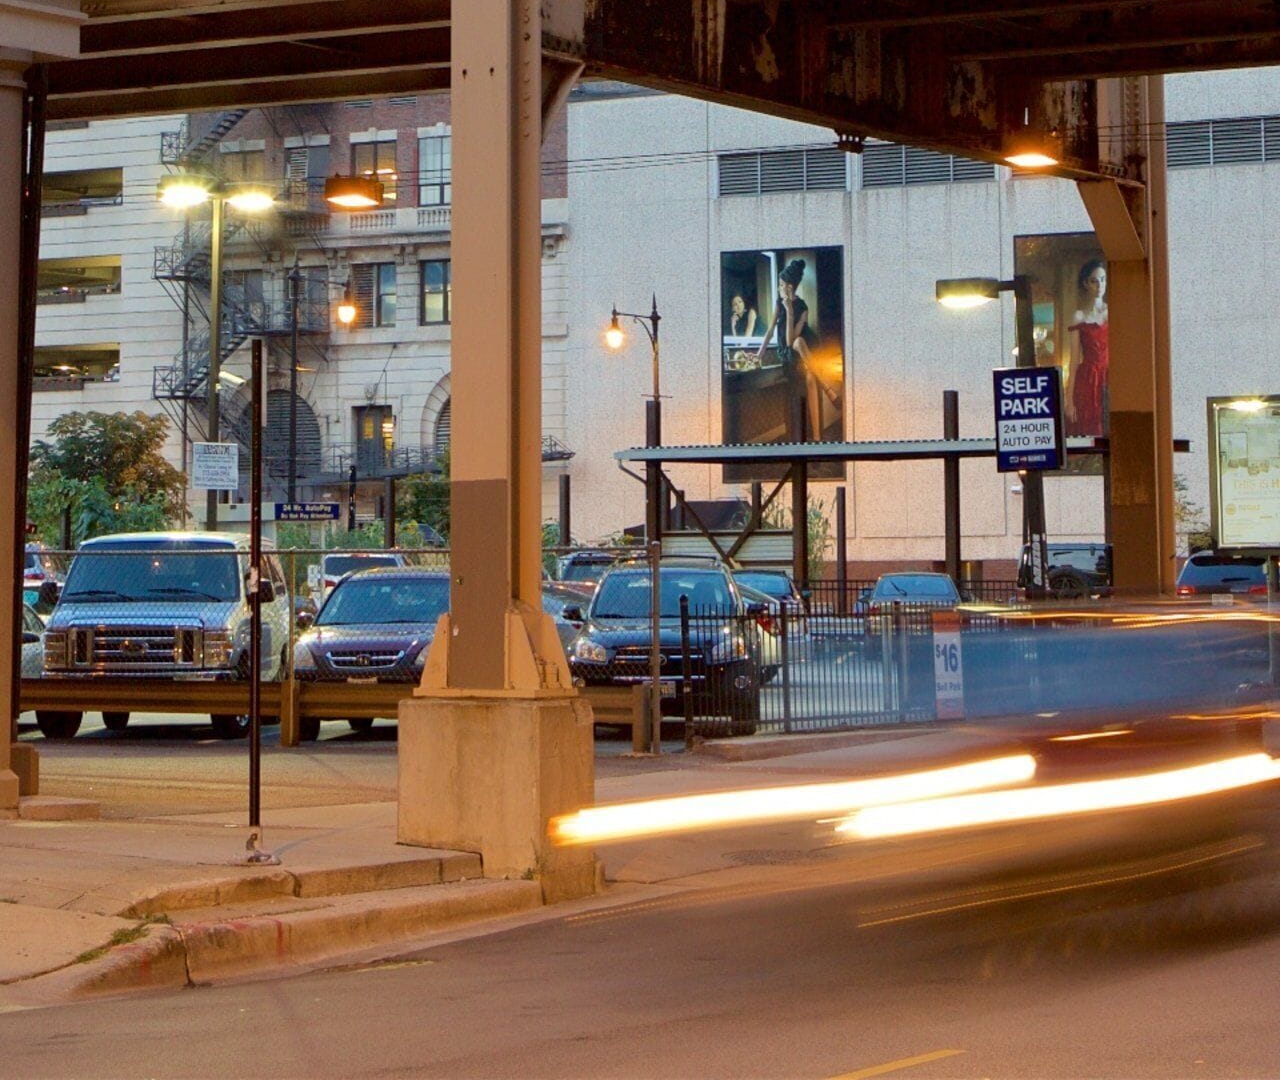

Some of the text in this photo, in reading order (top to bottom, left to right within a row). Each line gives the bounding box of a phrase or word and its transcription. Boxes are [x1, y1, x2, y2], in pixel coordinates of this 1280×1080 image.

[1001, 376, 1049, 395] SELF
[1001, 397, 1050, 415] PARK
[1003, 423, 1050, 434] 24 HOUR
[1002, 435, 1052, 446] AUTO PAY
[1234, 479, 1256, 489] THIS
